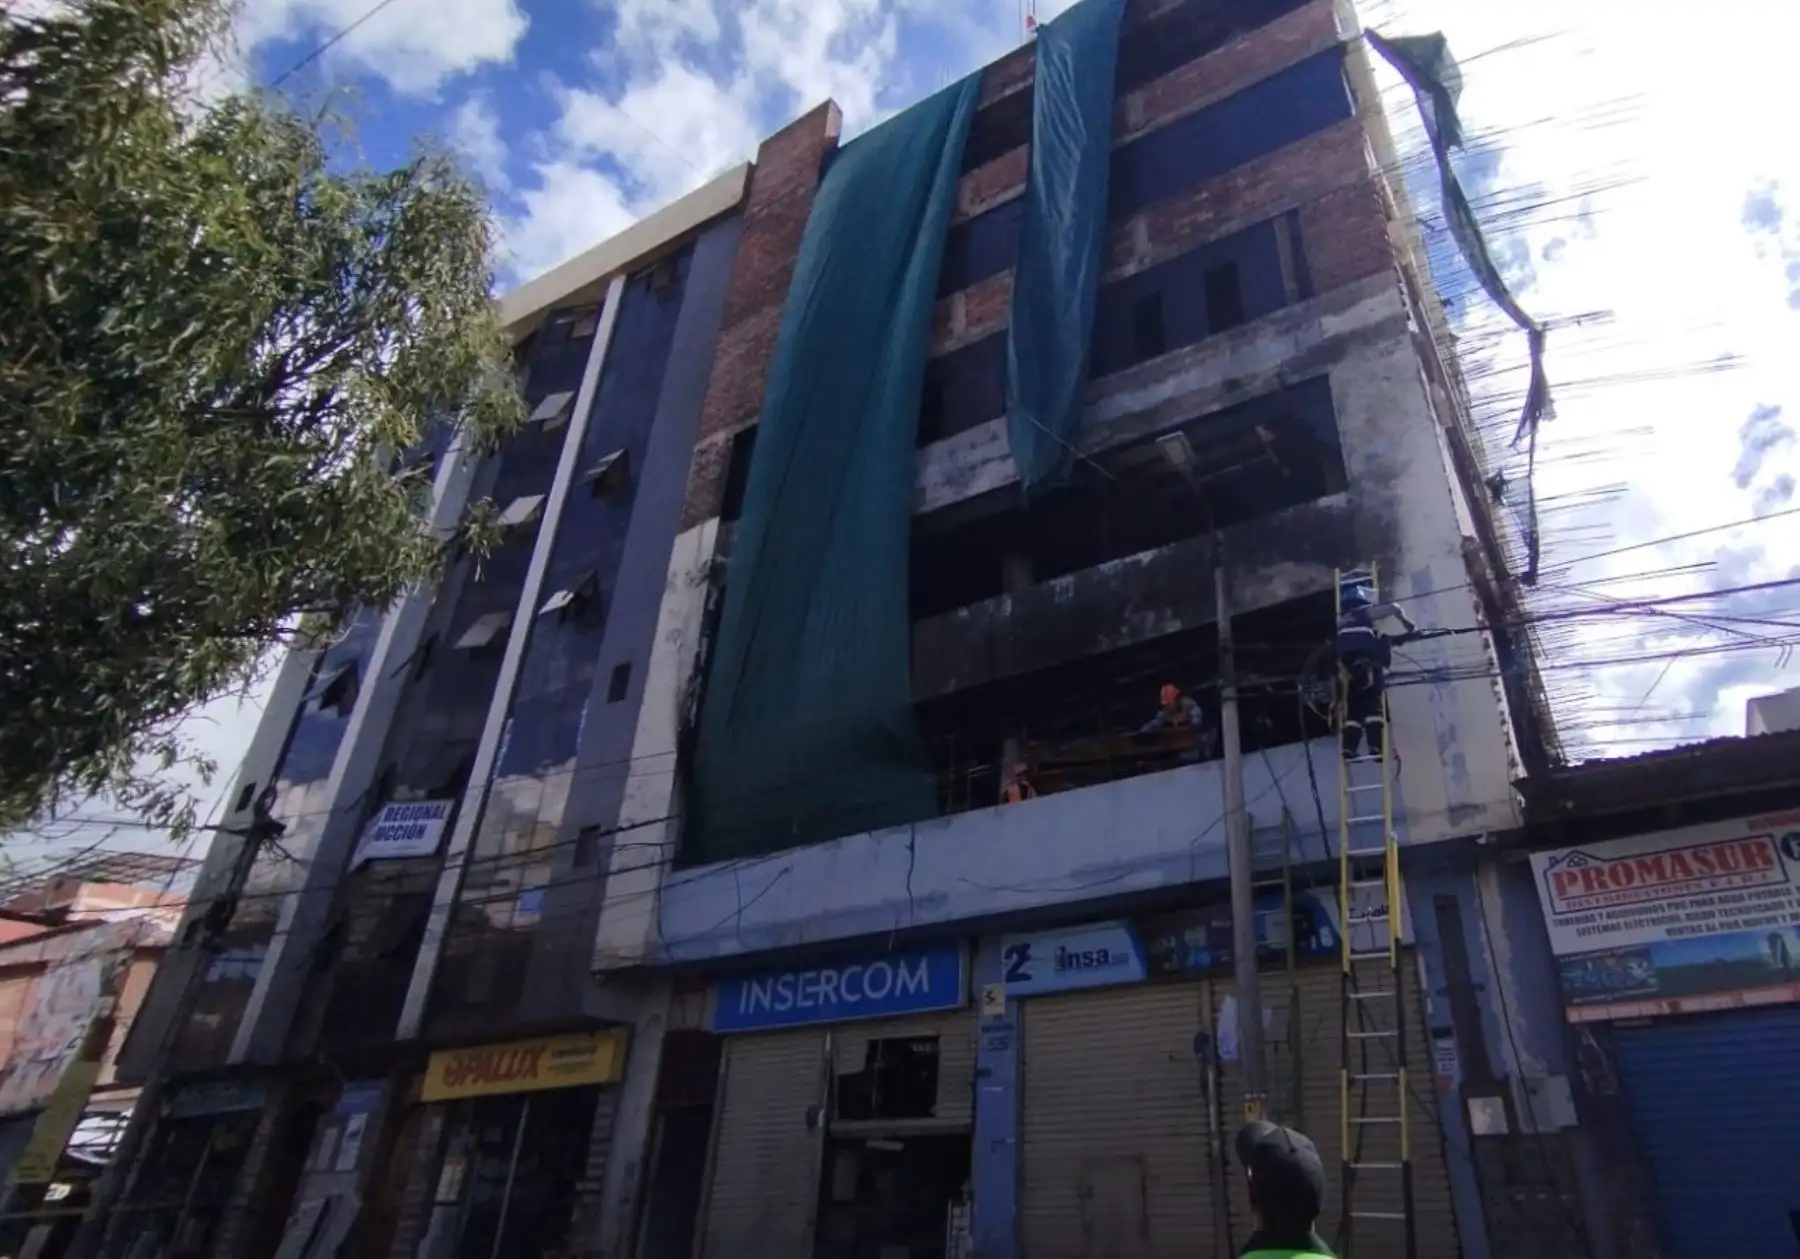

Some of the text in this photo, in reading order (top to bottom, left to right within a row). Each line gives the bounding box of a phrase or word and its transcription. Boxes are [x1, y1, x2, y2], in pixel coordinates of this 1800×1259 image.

[383, 803, 446, 822] REGIONAL
[1553, 841, 1776, 897] PROMASUR
[738, 956, 930, 1015] INSERCOM
